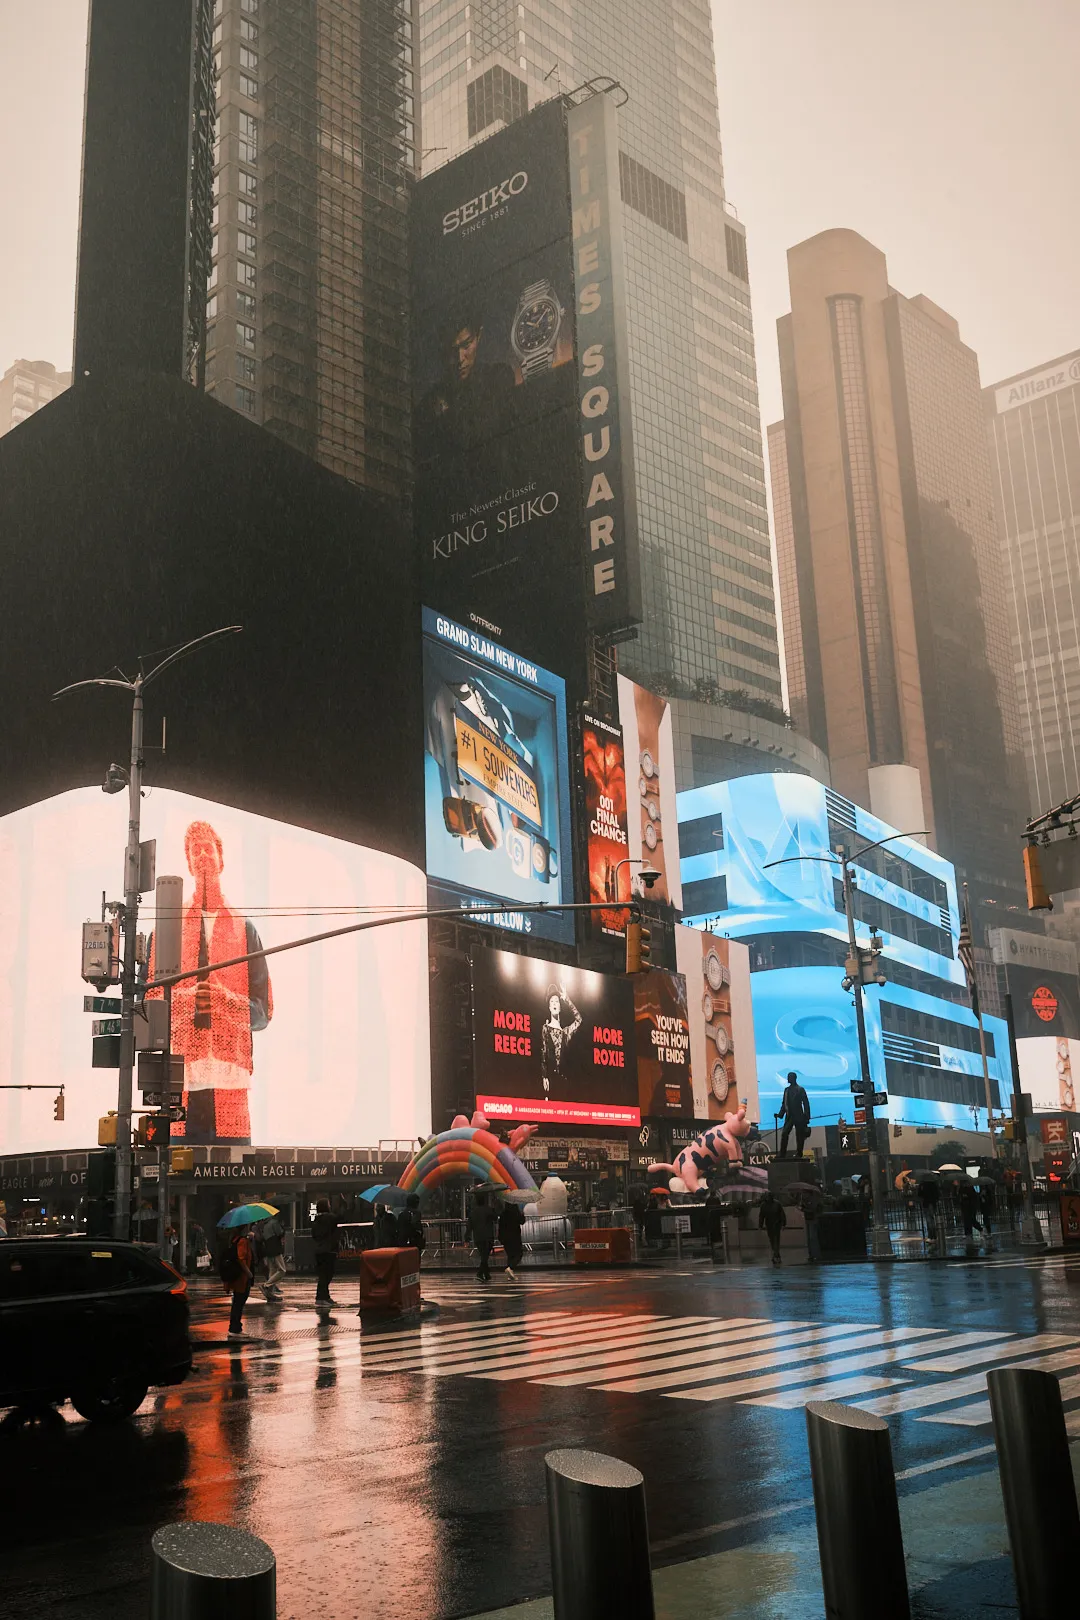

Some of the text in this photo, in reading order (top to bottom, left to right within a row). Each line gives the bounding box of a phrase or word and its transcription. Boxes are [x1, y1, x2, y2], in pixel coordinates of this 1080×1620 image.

[442, 171, 528, 235] SEIKO
[461, 205, 510, 237] SINCE 1881
[572, 126, 602, 315] TIMES
[1008, 372, 1066, 404] Allianz
[580, 343, 616, 596] SQUARE
[450, 480, 537, 524] The Newest Classic
[432, 491, 559, 560] KING SEIKO
[436, 617, 539, 684] GRAND SLAM NEW YORK
[478, 721, 519, 765] NEW YORK
[461, 730, 537, 808] #1 SOUVENIRS
[599, 794, 614, 811] 001
[596, 807, 621, 829] FINAL
[590, 820, 627, 845] CHANCE
[493, 912, 524, 931] BELOW
[1019, 943, 1042, 957] HYATT
[100, 999, 105, 1012] 7
[107, 1020, 116, 1033] 46
[493, 1009, 531, 1033] MORE
[494, 1033, 532, 1057] REECE
[592, 1026, 624, 1047] MORE
[651, 1030, 689, 1050] SEEN HOW
[593, 1048, 625, 1068] ROXIE
[657, 1046, 685, 1065] IT ENDS
[483, 1102, 513, 1115] CHICAGO
[193, 1165, 257, 1178] AMERICAN
[261, 1164, 296, 1177] EAGLE
[341, 1164, 384, 1176] OFFLINE
[638, 1156, 657, 1165] HEYTEA
[1, 1176, 29, 1190] EAGLE
